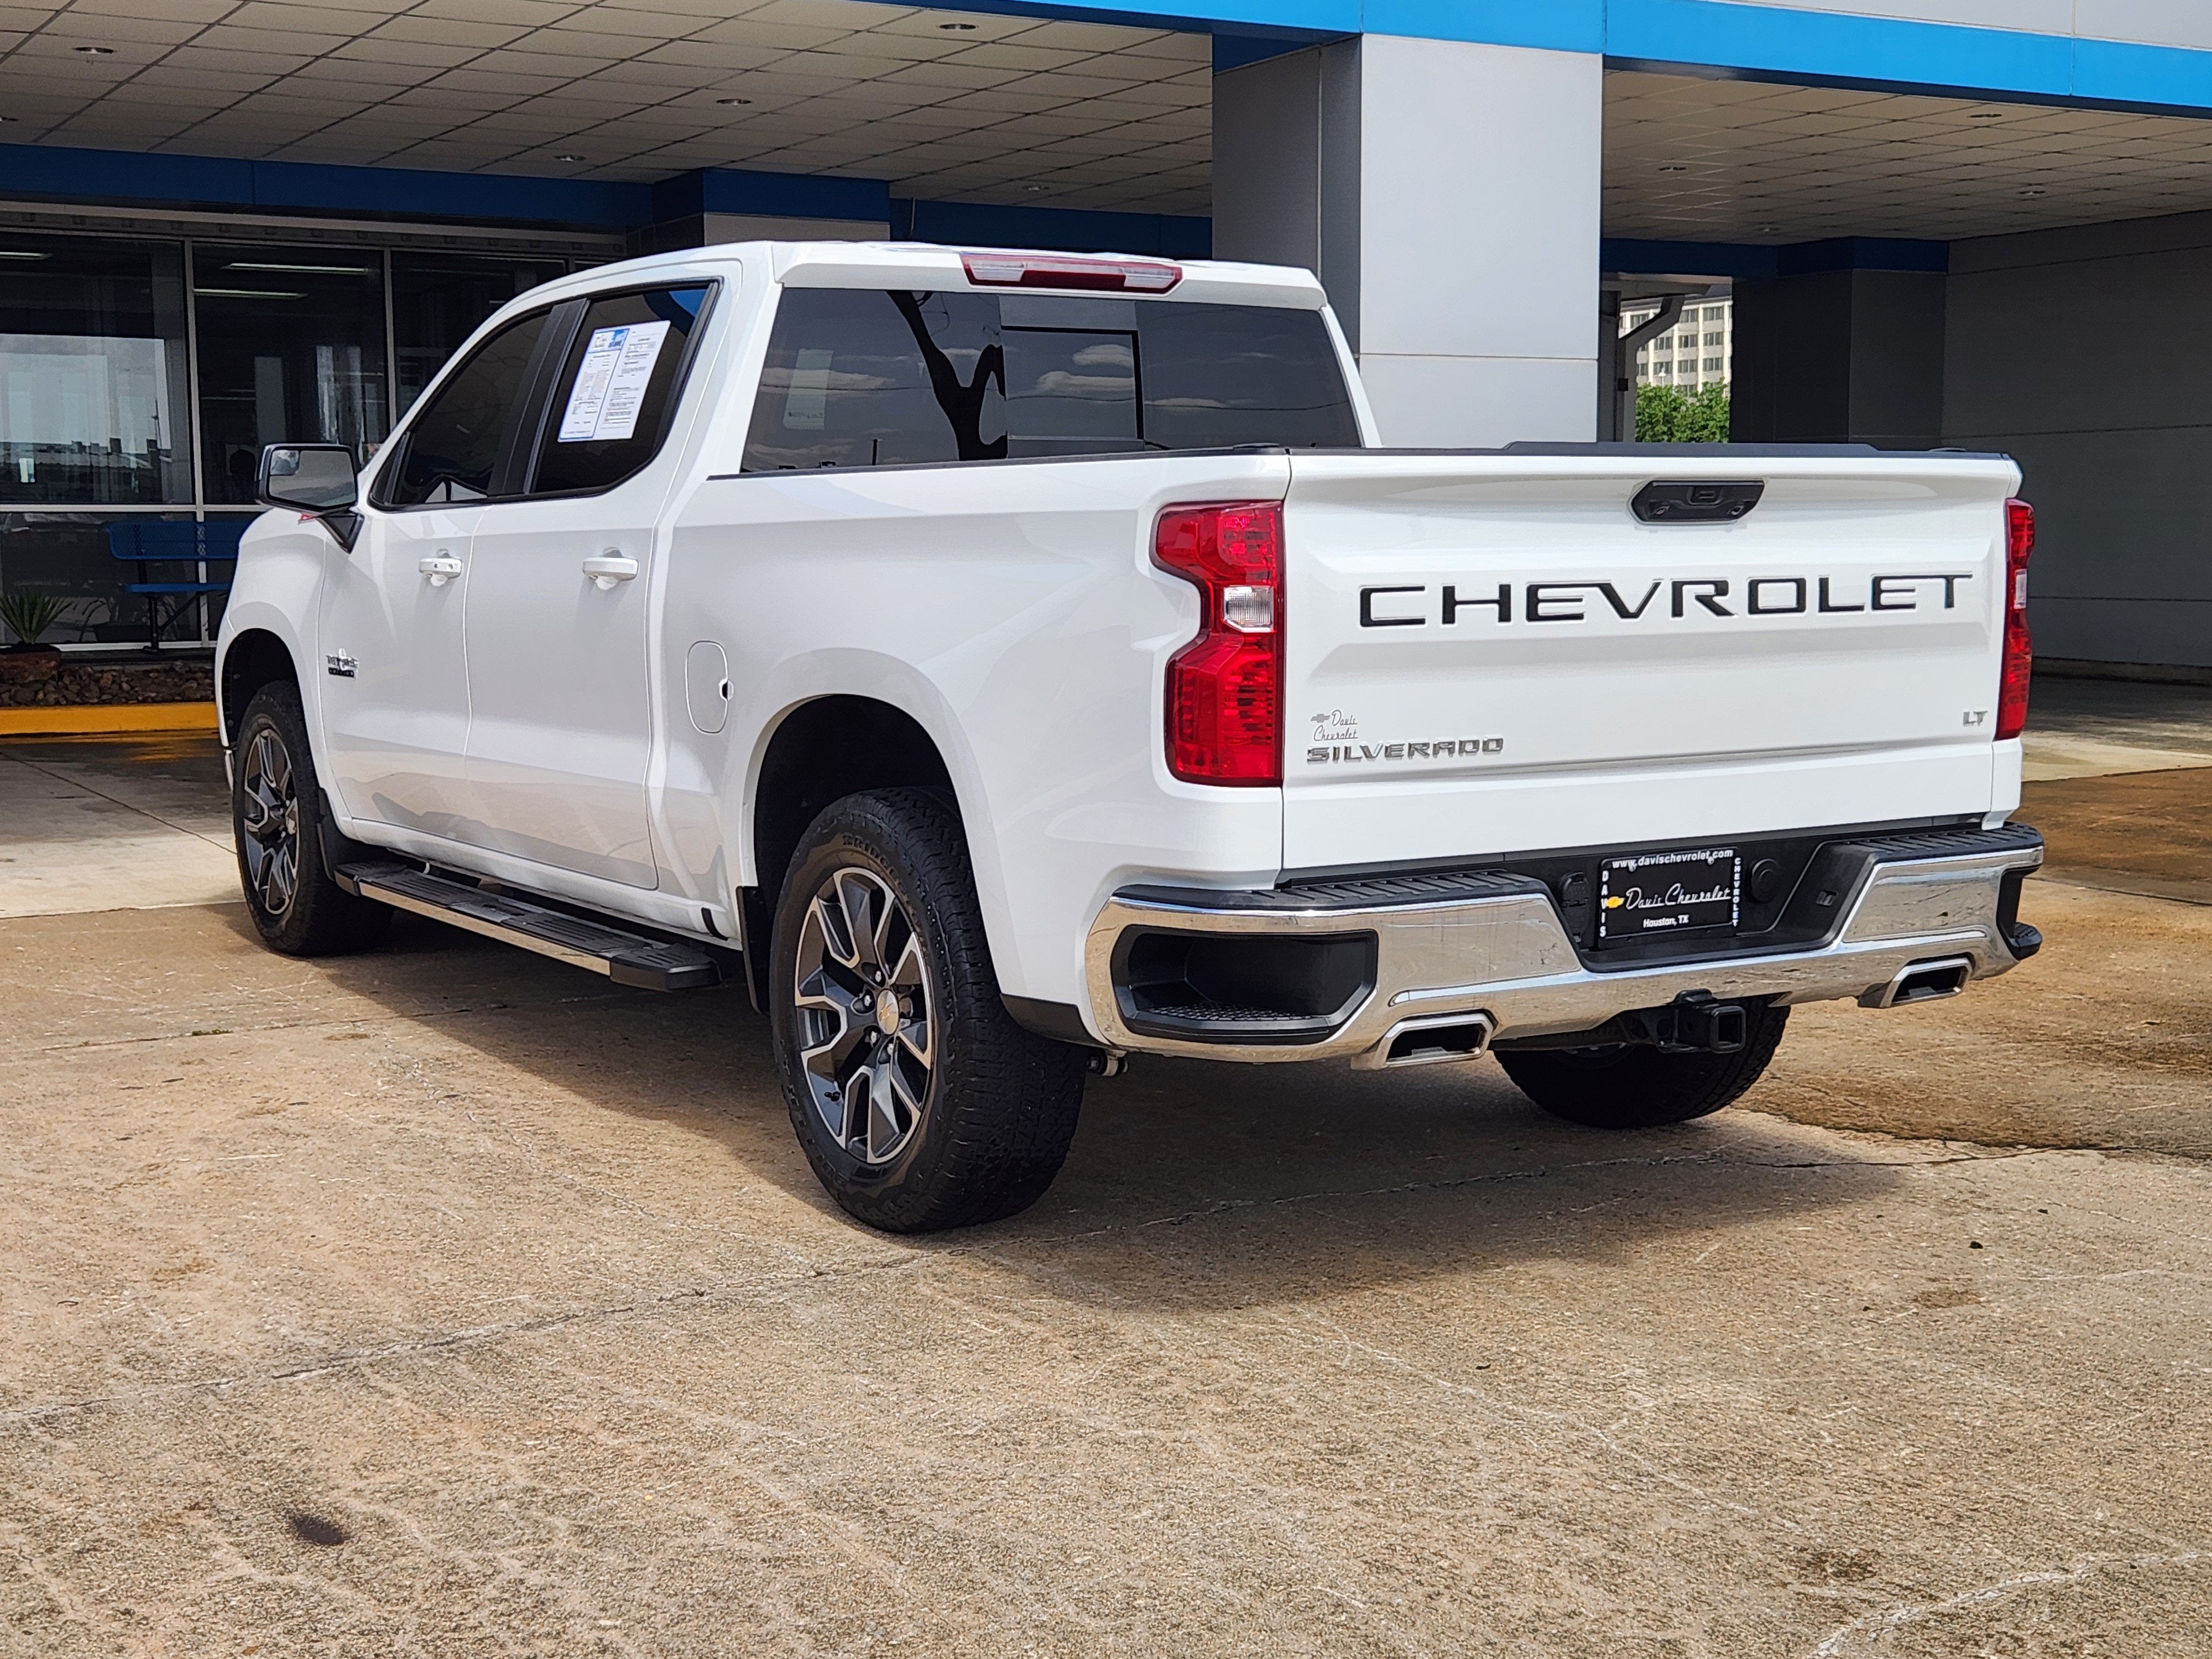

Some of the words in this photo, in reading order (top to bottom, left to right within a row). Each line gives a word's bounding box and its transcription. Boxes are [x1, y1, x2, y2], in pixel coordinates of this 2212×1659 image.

[1360, 574, 1973, 627] CHEVROLET
[1332, 709, 1358, 726] Davis
[1963, 710, 1988, 727] LT
[1313, 724, 1358, 741] Chevrolet
[1307, 737, 1504, 763] SILVERADO
[1612, 849, 1734, 869] www.davischevrolet.com
[1600, 870, 1609, 937] DAVIS
[1625, 887, 1665, 910] Davis
[1665, 883, 1731, 905] Chevrolet
[1732, 858, 1741, 927] CHEVROLET
[1643, 916, 1677, 928] Houston,
[1678, 914, 1689, 924] TX
